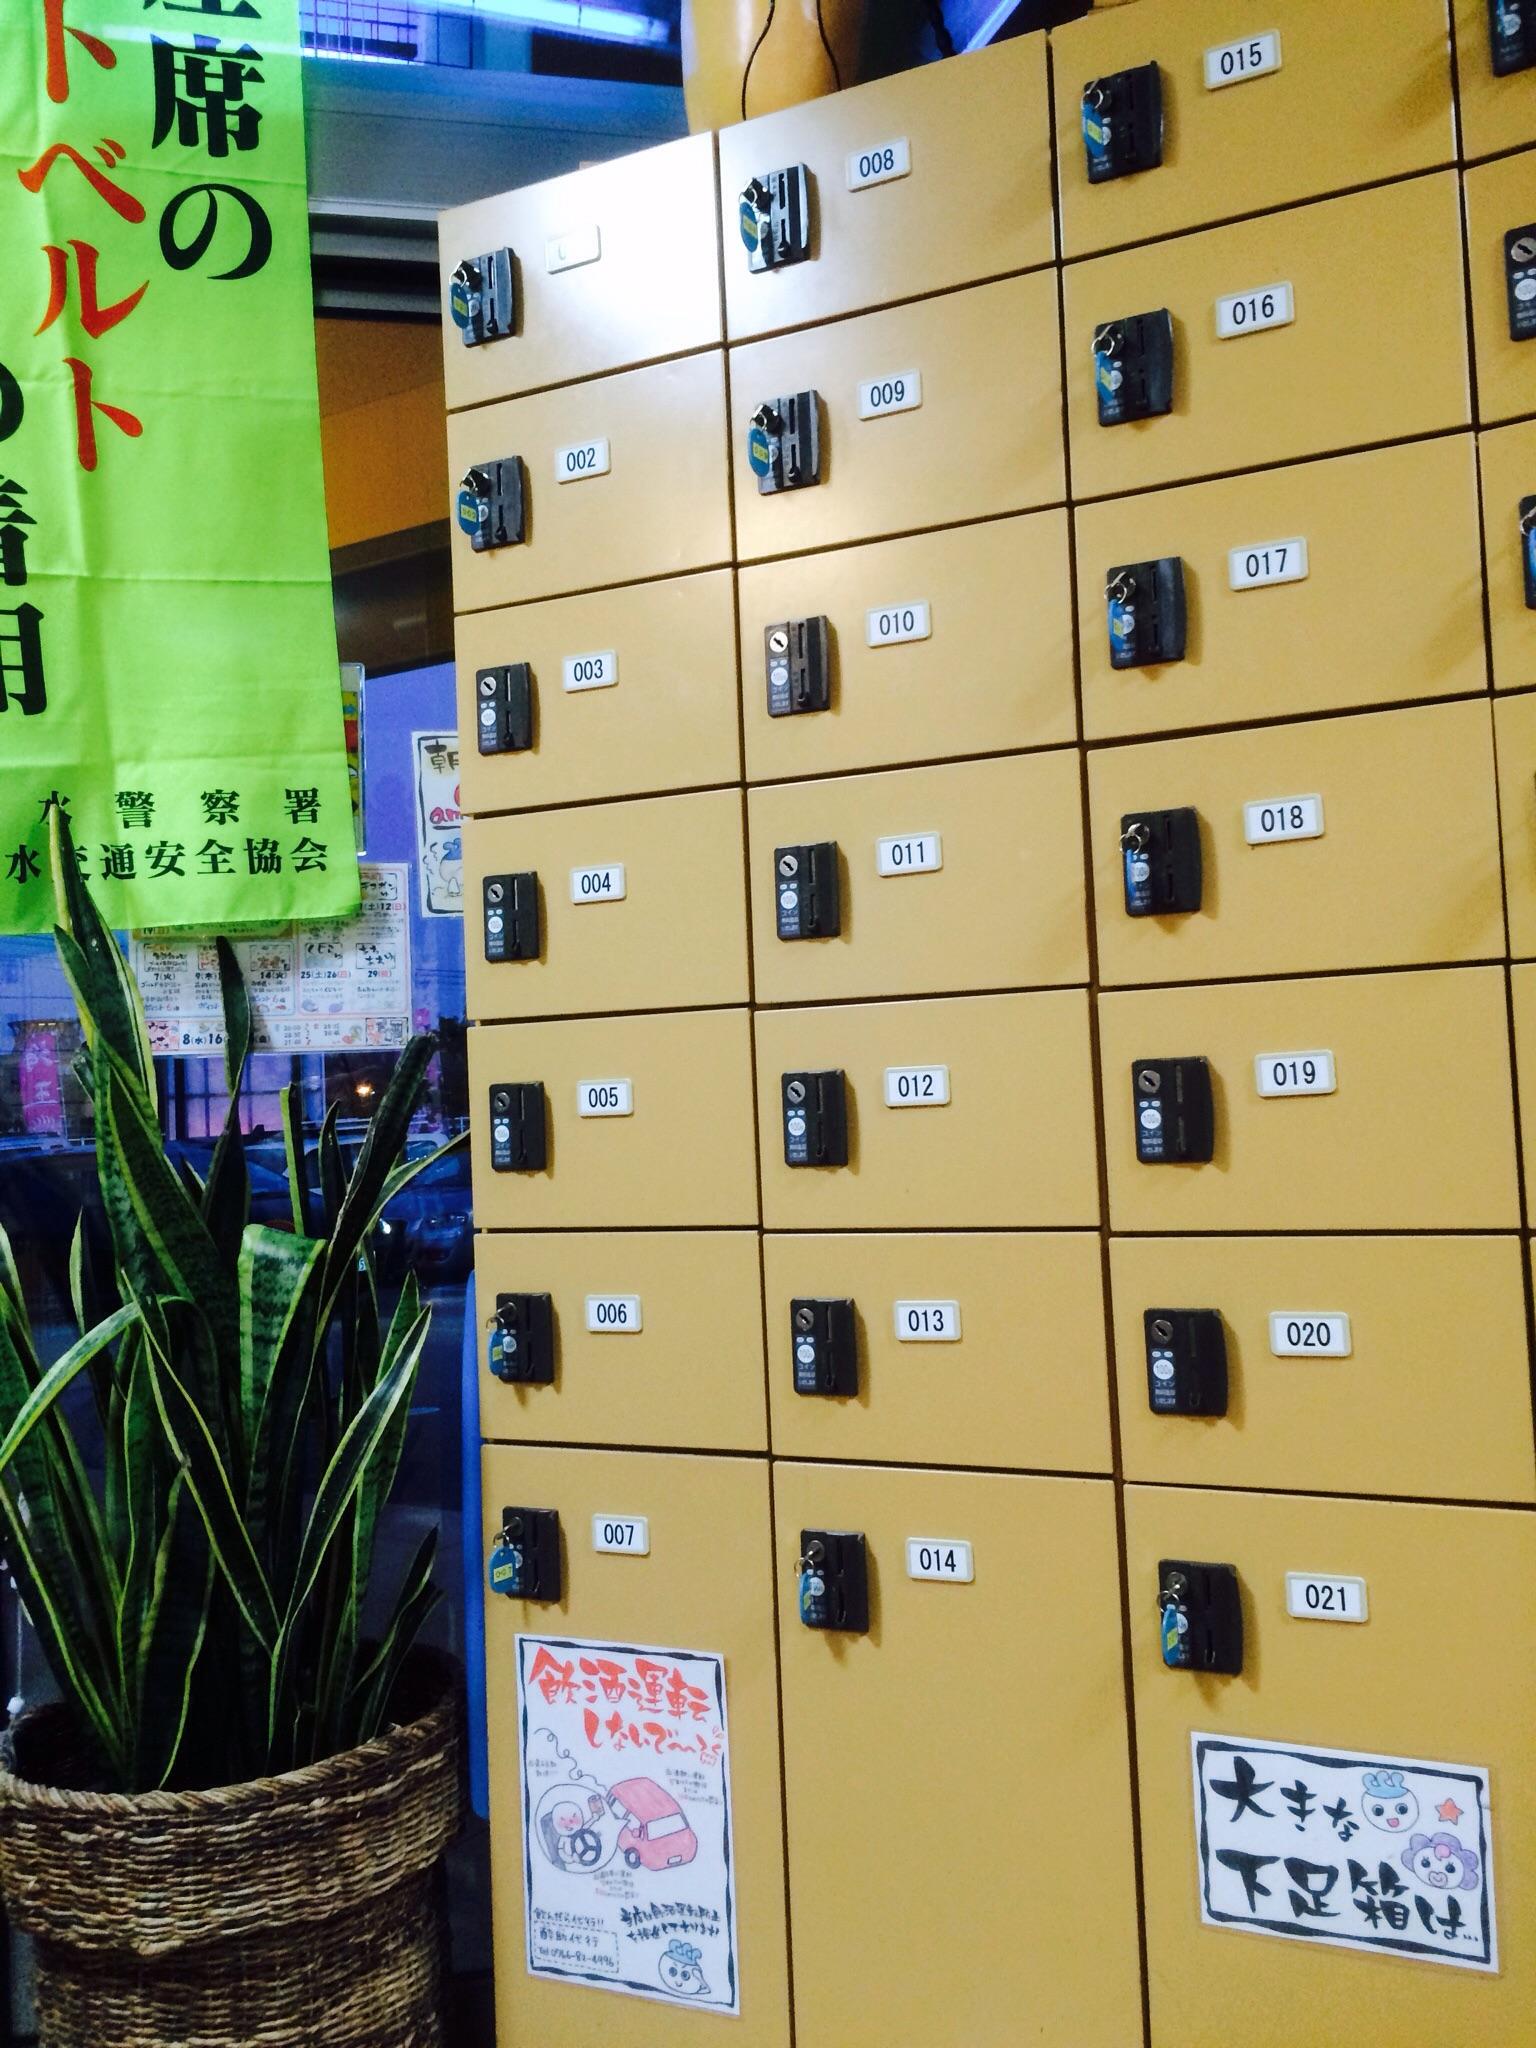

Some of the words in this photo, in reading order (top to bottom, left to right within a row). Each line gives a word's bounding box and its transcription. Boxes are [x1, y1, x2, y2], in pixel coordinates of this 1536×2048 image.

[1221, 43, 1261, 74] 015
[143, 0, 272, 280] 席の
[860, 149, 894, 177] 008
[1233, 295, 1274, 325] 016
[871, 381, 904, 407] 009
[567, 448, 595, 471] 002
[1247, 549, 1286, 577] 017
[880, 611, 913, 635] 010
[574, 659, 603, 681] 003
[1261, 806, 1303, 832] 018
[892, 842, 923, 865] 011
[582, 872, 611, 894] 004
[1274, 1061, 1315, 1086] 019
[589, 1087, 618, 1107] 005
[899, 1075, 933, 1097] 012
[597, 1304, 626, 1323] 006
[909, 1310, 943, 1331] 013
[1287, 1322, 1330, 1346] 020
[604, 1524, 633, 1545] 007
[920, 1548, 956, 1572] 014
[1306, 1584, 1345, 1611] 021
[529, 1646, 711, 1721] 飲酒運転
[1209, 1755, 1360, 1842] 大きな
